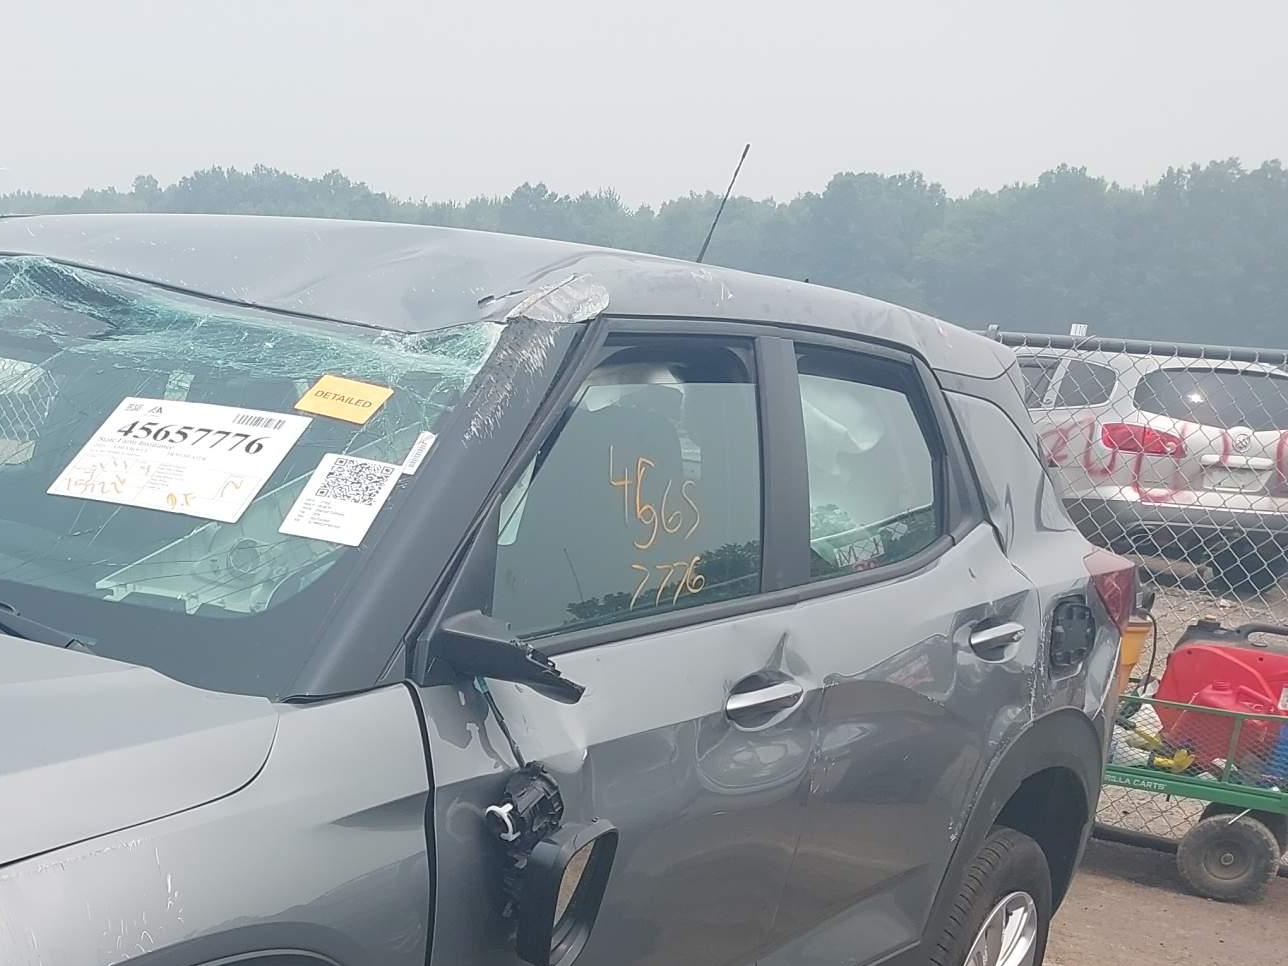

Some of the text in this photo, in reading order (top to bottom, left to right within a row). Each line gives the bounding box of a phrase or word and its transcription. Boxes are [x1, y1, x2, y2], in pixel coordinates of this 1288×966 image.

[314, 389, 373, 409] DETAILED
[116, 420, 272, 455] 45657776
[629, 556, 705, 611] 7776
